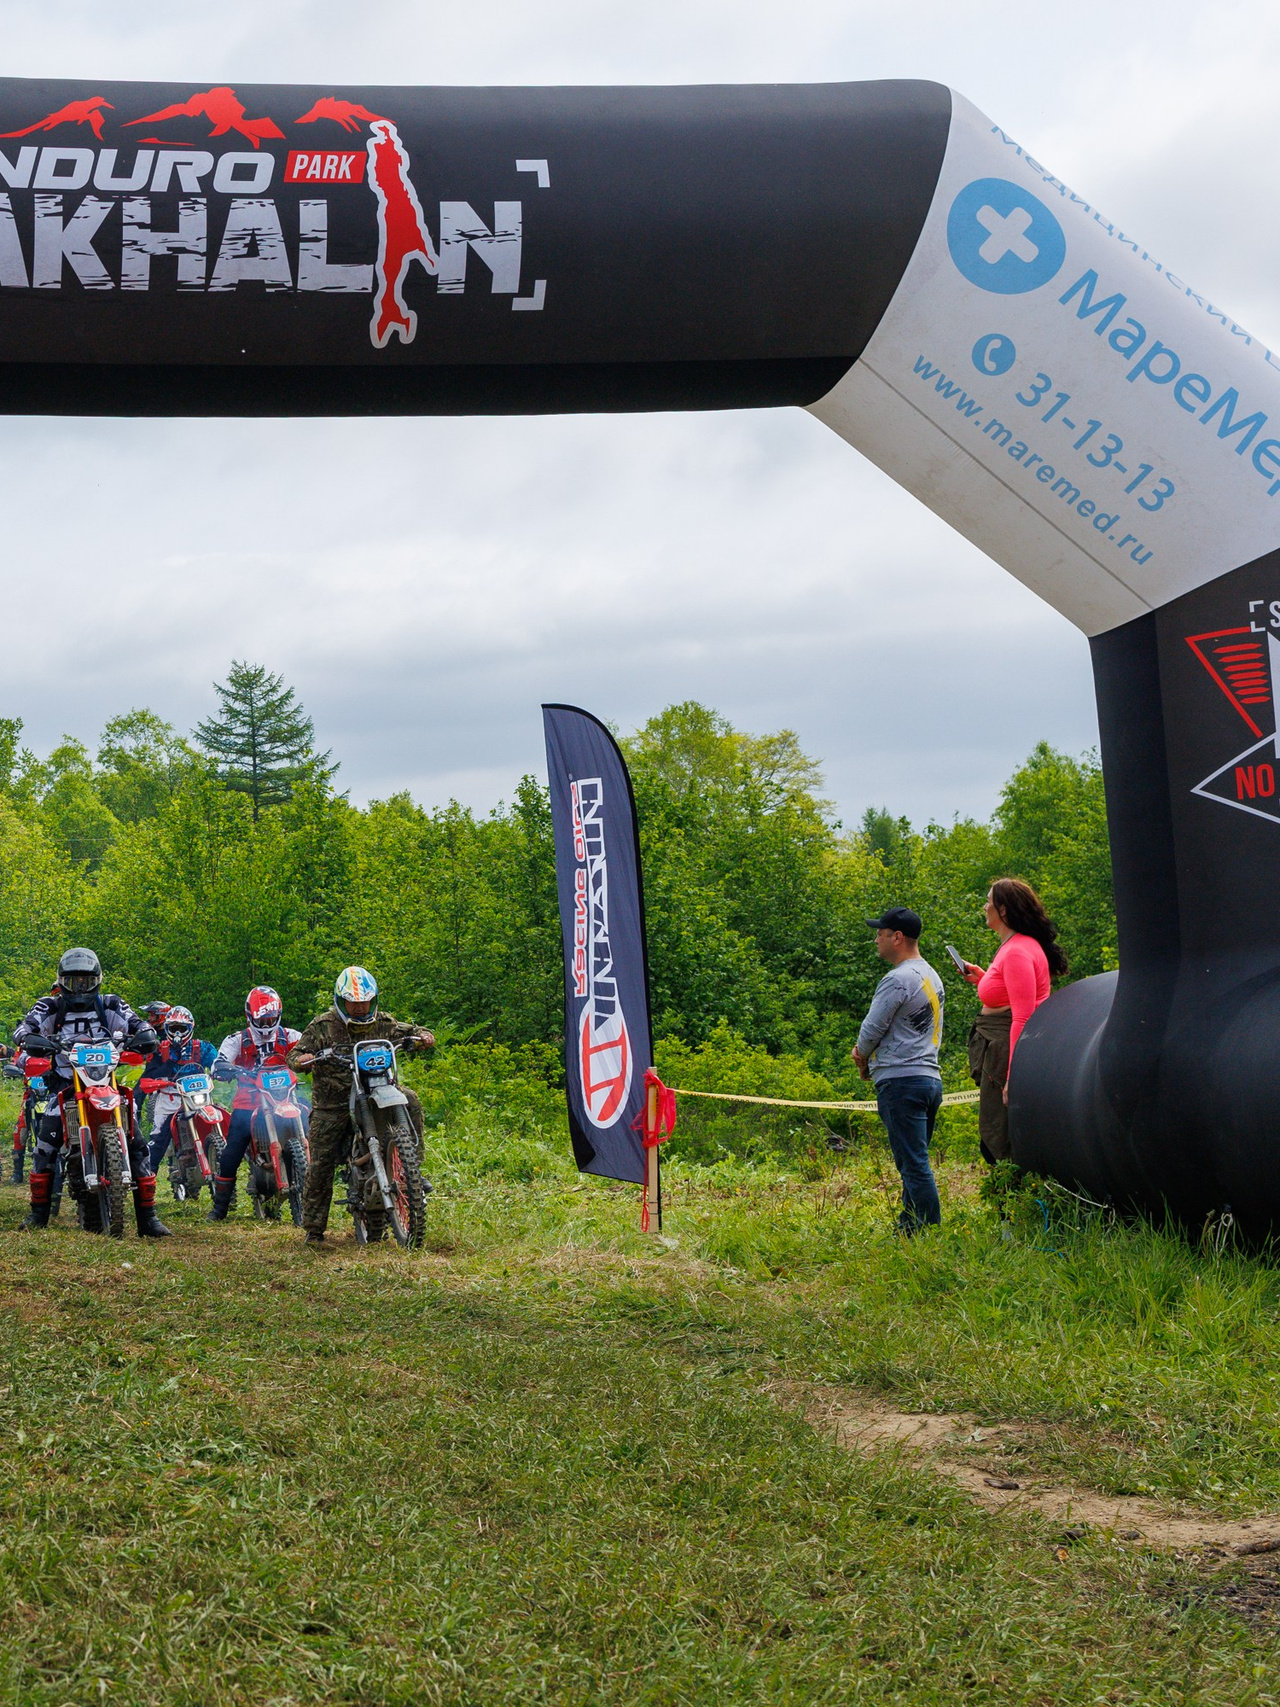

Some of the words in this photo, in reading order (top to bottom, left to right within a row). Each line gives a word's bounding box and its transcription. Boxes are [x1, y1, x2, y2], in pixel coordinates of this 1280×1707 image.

[292, 154, 353, 181] PARK
[1058, 268, 1280, 498] МареМе
[1015, 372, 1175, 512] 31-13-13
[912, 354, 1153, 566] www.maremed.ru
[1235, 763, 1276, 800] NO
[85, 1053, 105, 1062] 20
[365, 1056, 386, 1067] 42
[188, 1081, 203, 1090] 48
[269, 1077, 285, 1086] 37
